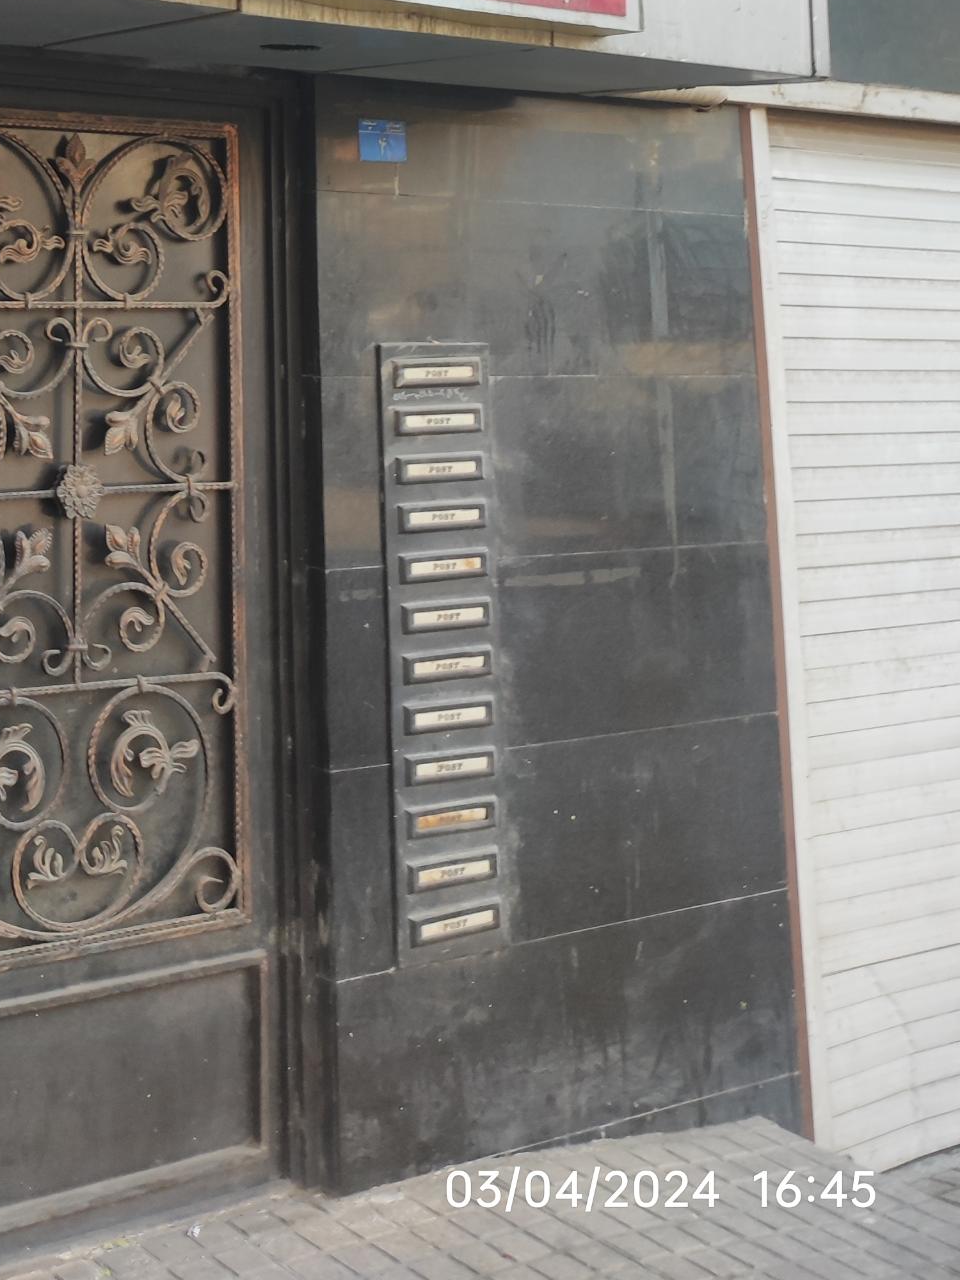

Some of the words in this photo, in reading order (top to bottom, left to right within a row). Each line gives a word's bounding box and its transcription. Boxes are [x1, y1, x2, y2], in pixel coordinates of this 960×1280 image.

[426, 417, 451, 425] POST
[428, 465, 453, 473] POST
[432, 513, 456, 521] POST
[433, 562, 457, 571] POST
[436, 612, 461, 621] POST
[435, 662, 460, 670] POST
[437, 763, 463, 772] POST
[440, 867, 466, 878] POST
[443, 919, 468, 931] POST
